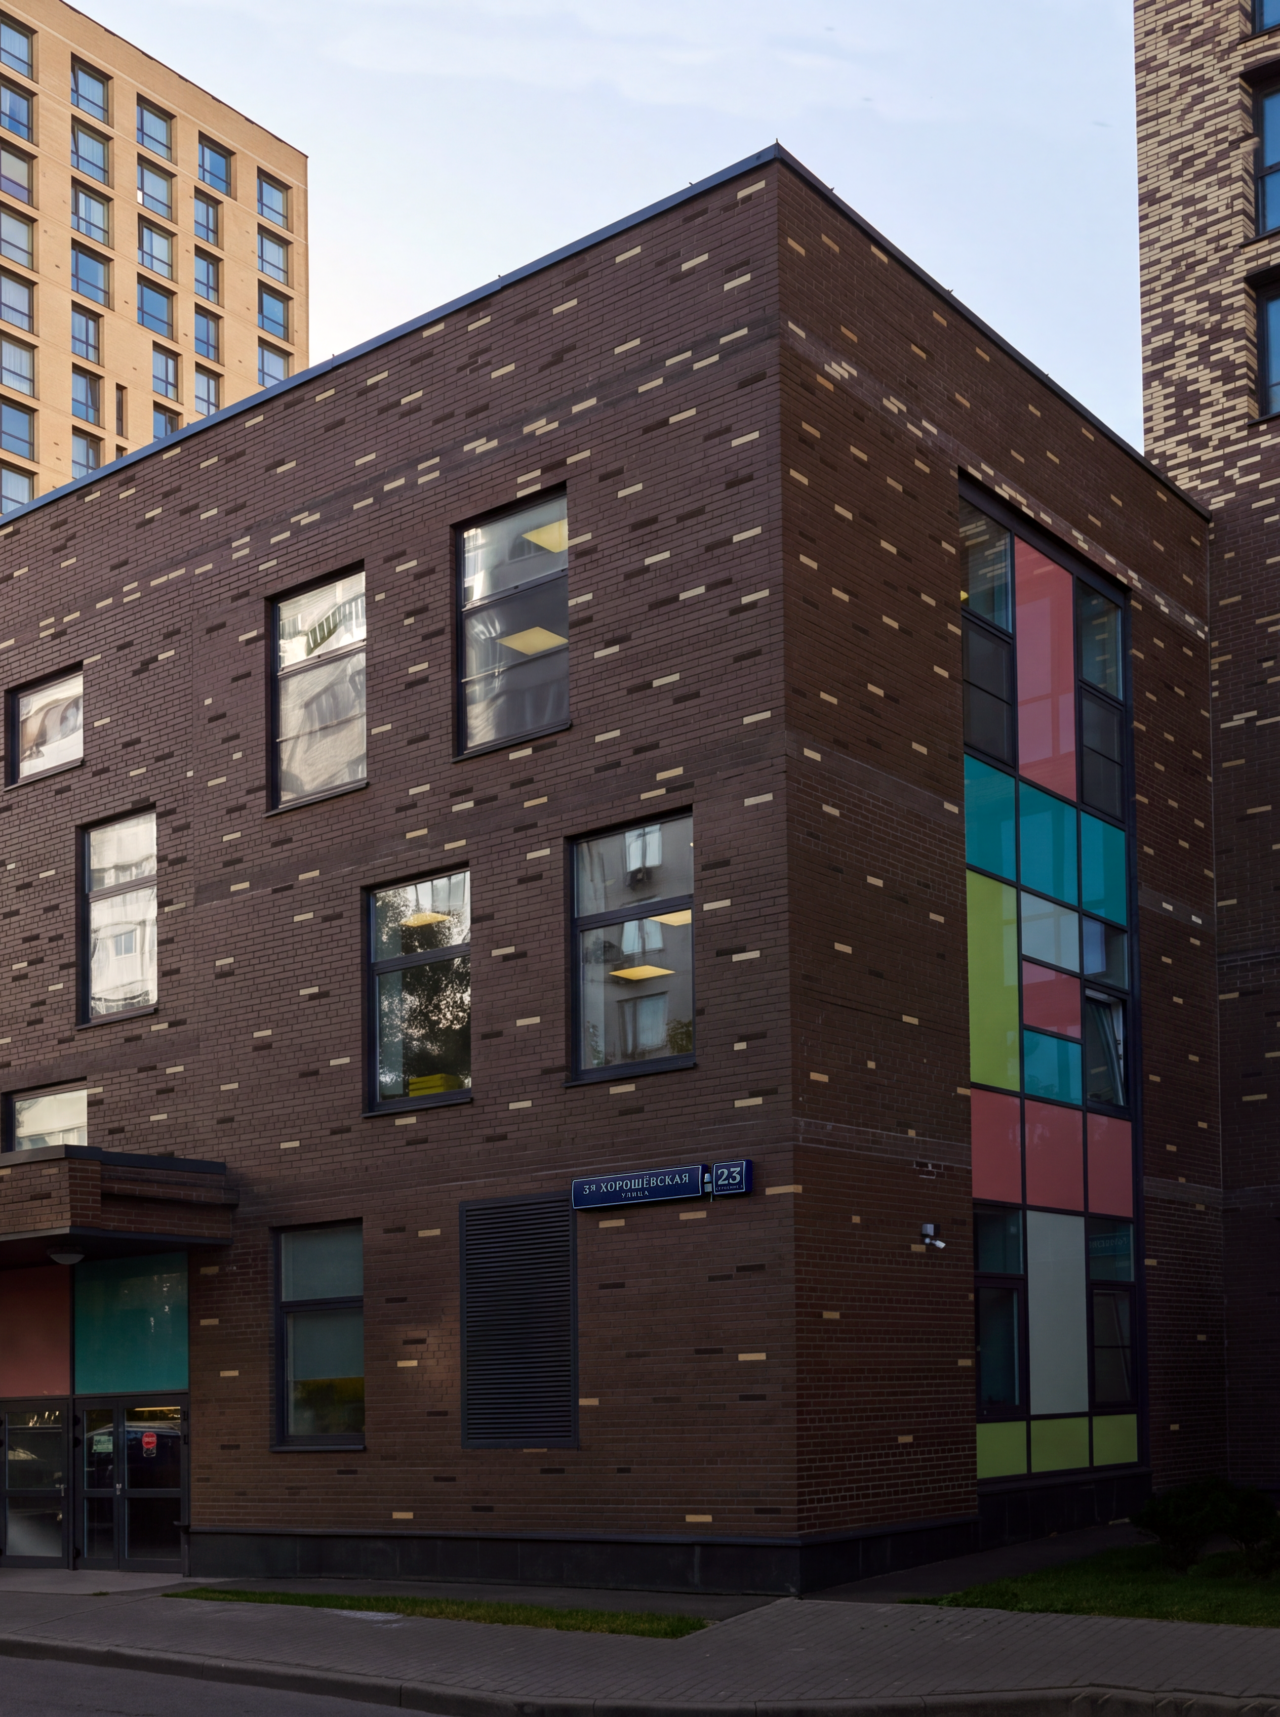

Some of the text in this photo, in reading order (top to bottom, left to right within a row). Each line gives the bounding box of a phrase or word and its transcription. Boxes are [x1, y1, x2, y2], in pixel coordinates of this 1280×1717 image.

[600, 1173, 689, 1193] ХОРОШЁВСКАЯ
[717, 1167, 741, 1185] 23
[621, 1190, 649, 1198] УЛИЦА
